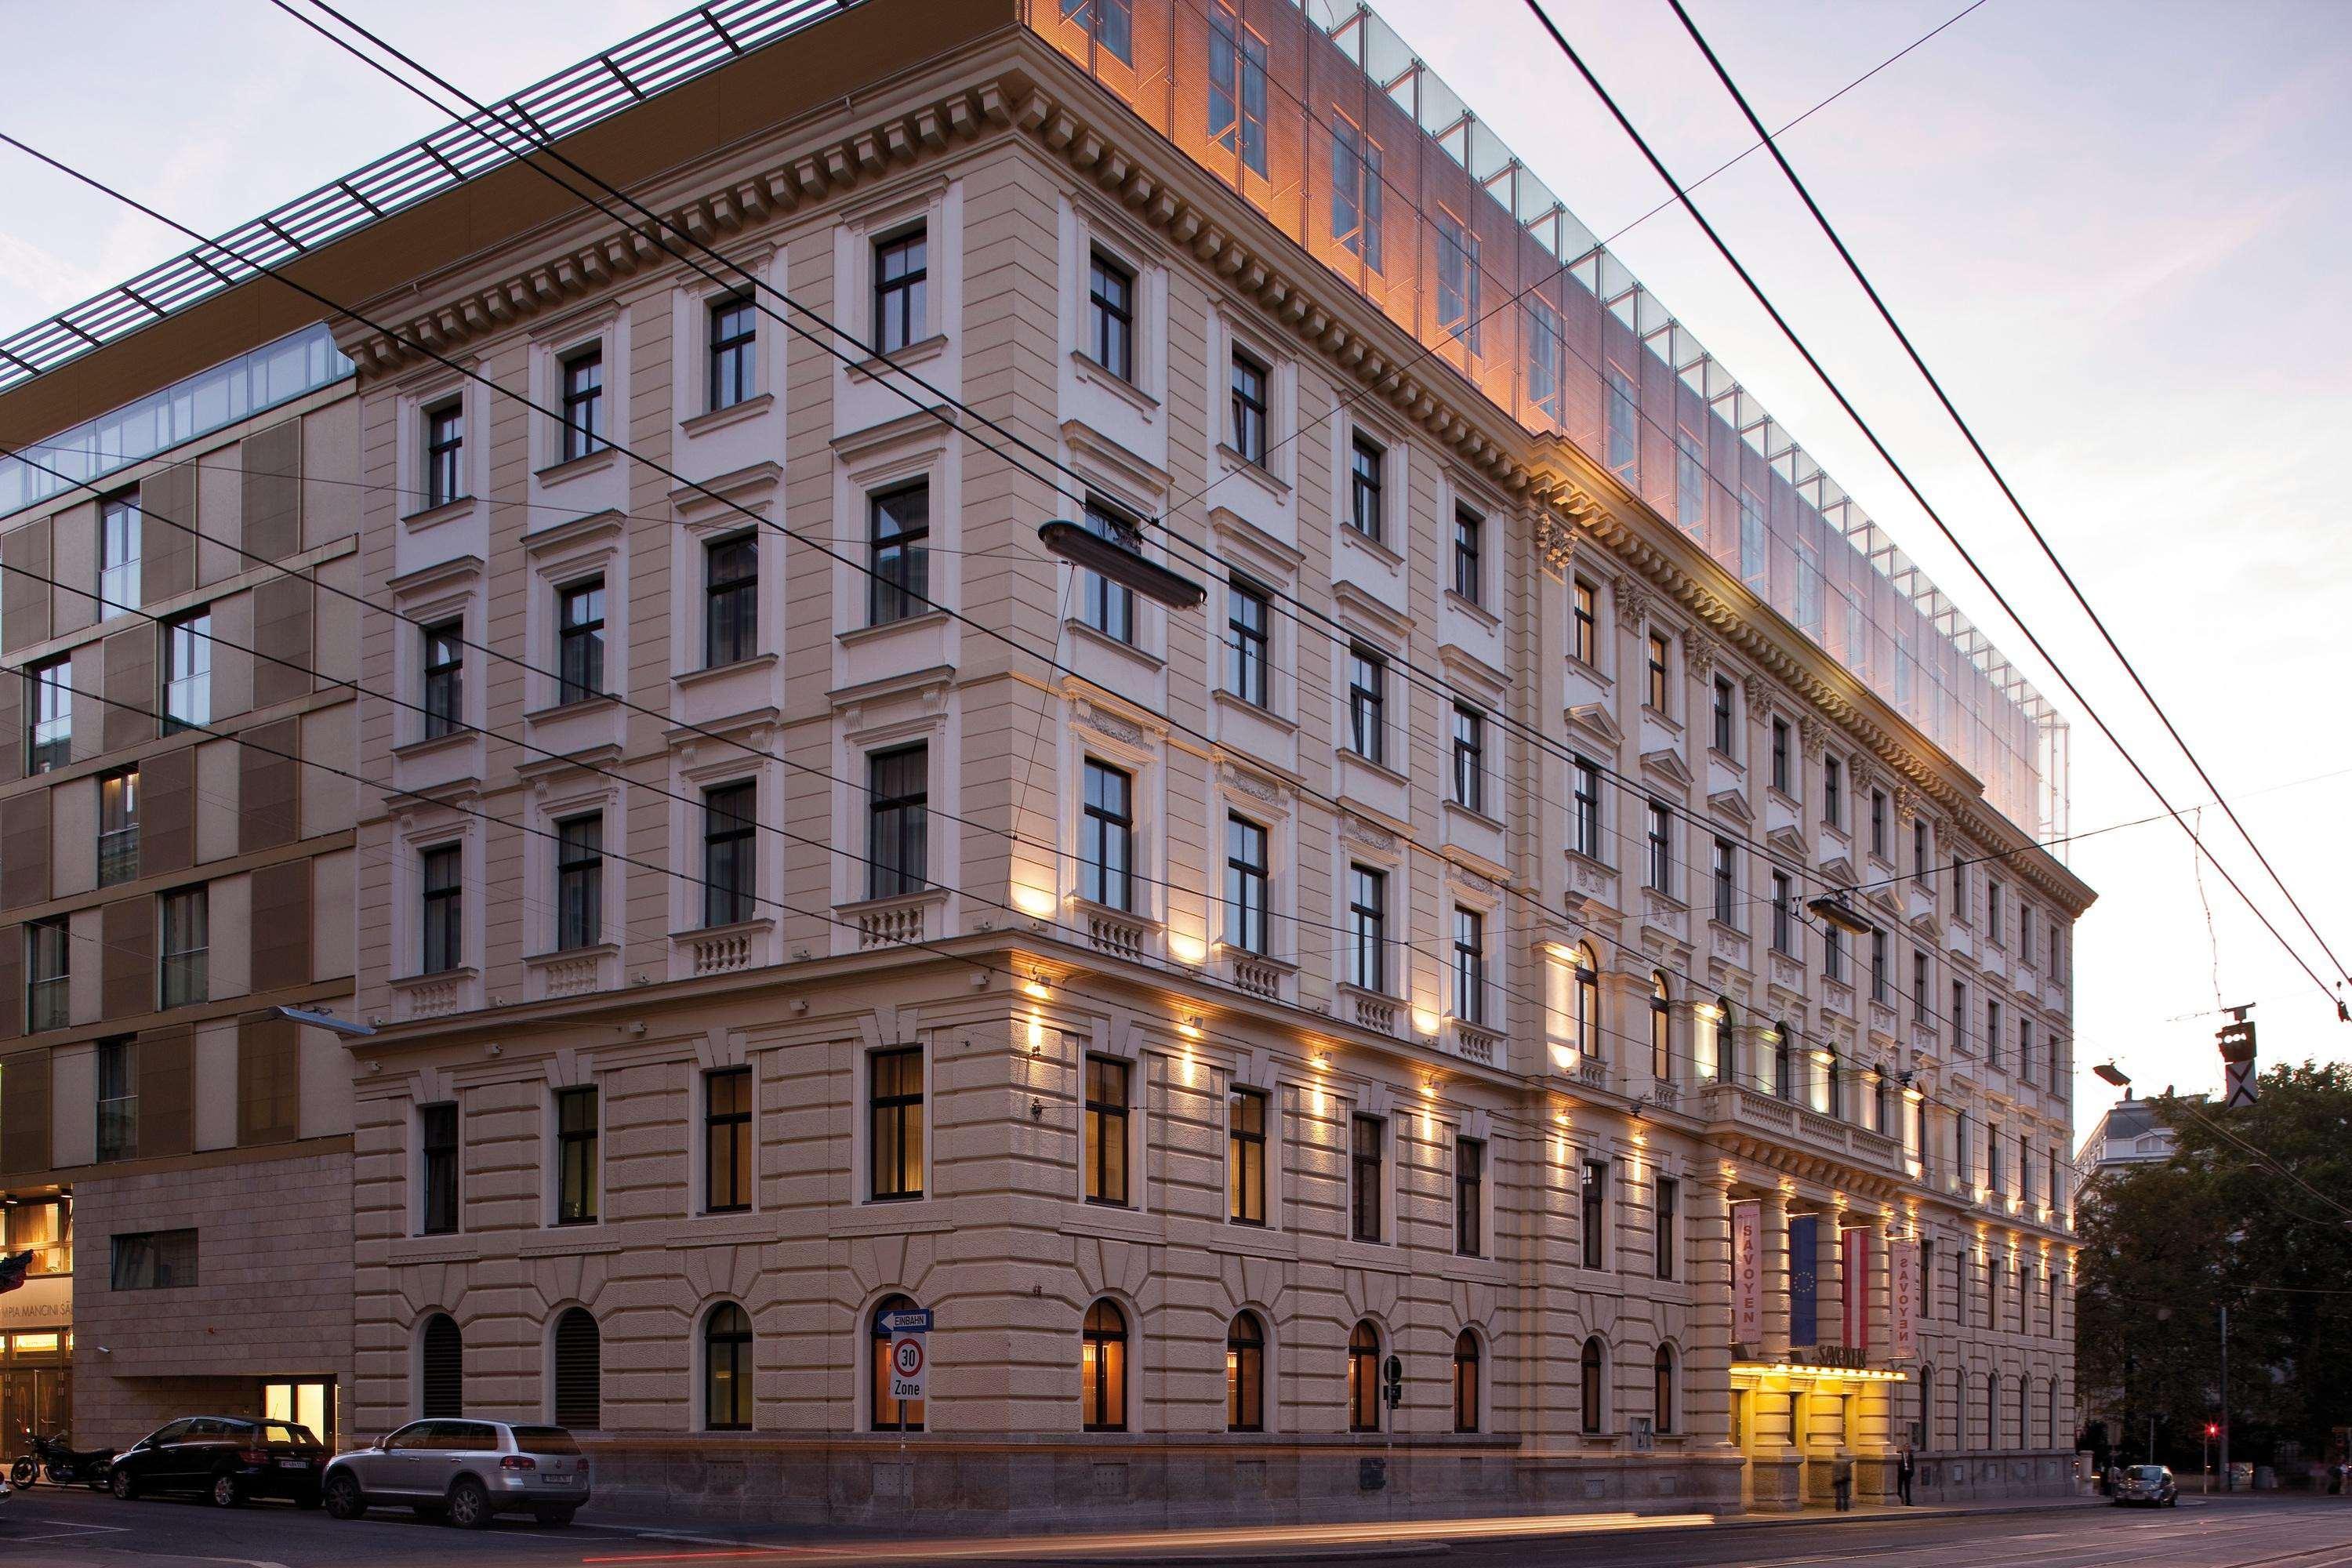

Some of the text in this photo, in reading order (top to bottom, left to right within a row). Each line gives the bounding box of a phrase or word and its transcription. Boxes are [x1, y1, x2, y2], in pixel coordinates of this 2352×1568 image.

[1743, 1225, 1755, 1323] SAVOYEN
[22, 1305, 59, 1318] MANCINI
[895, 1316, 924, 1327] EINBAHN
[902, 1349, 916, 1367] 30
[895, 1380, 920, 1396] Zone
